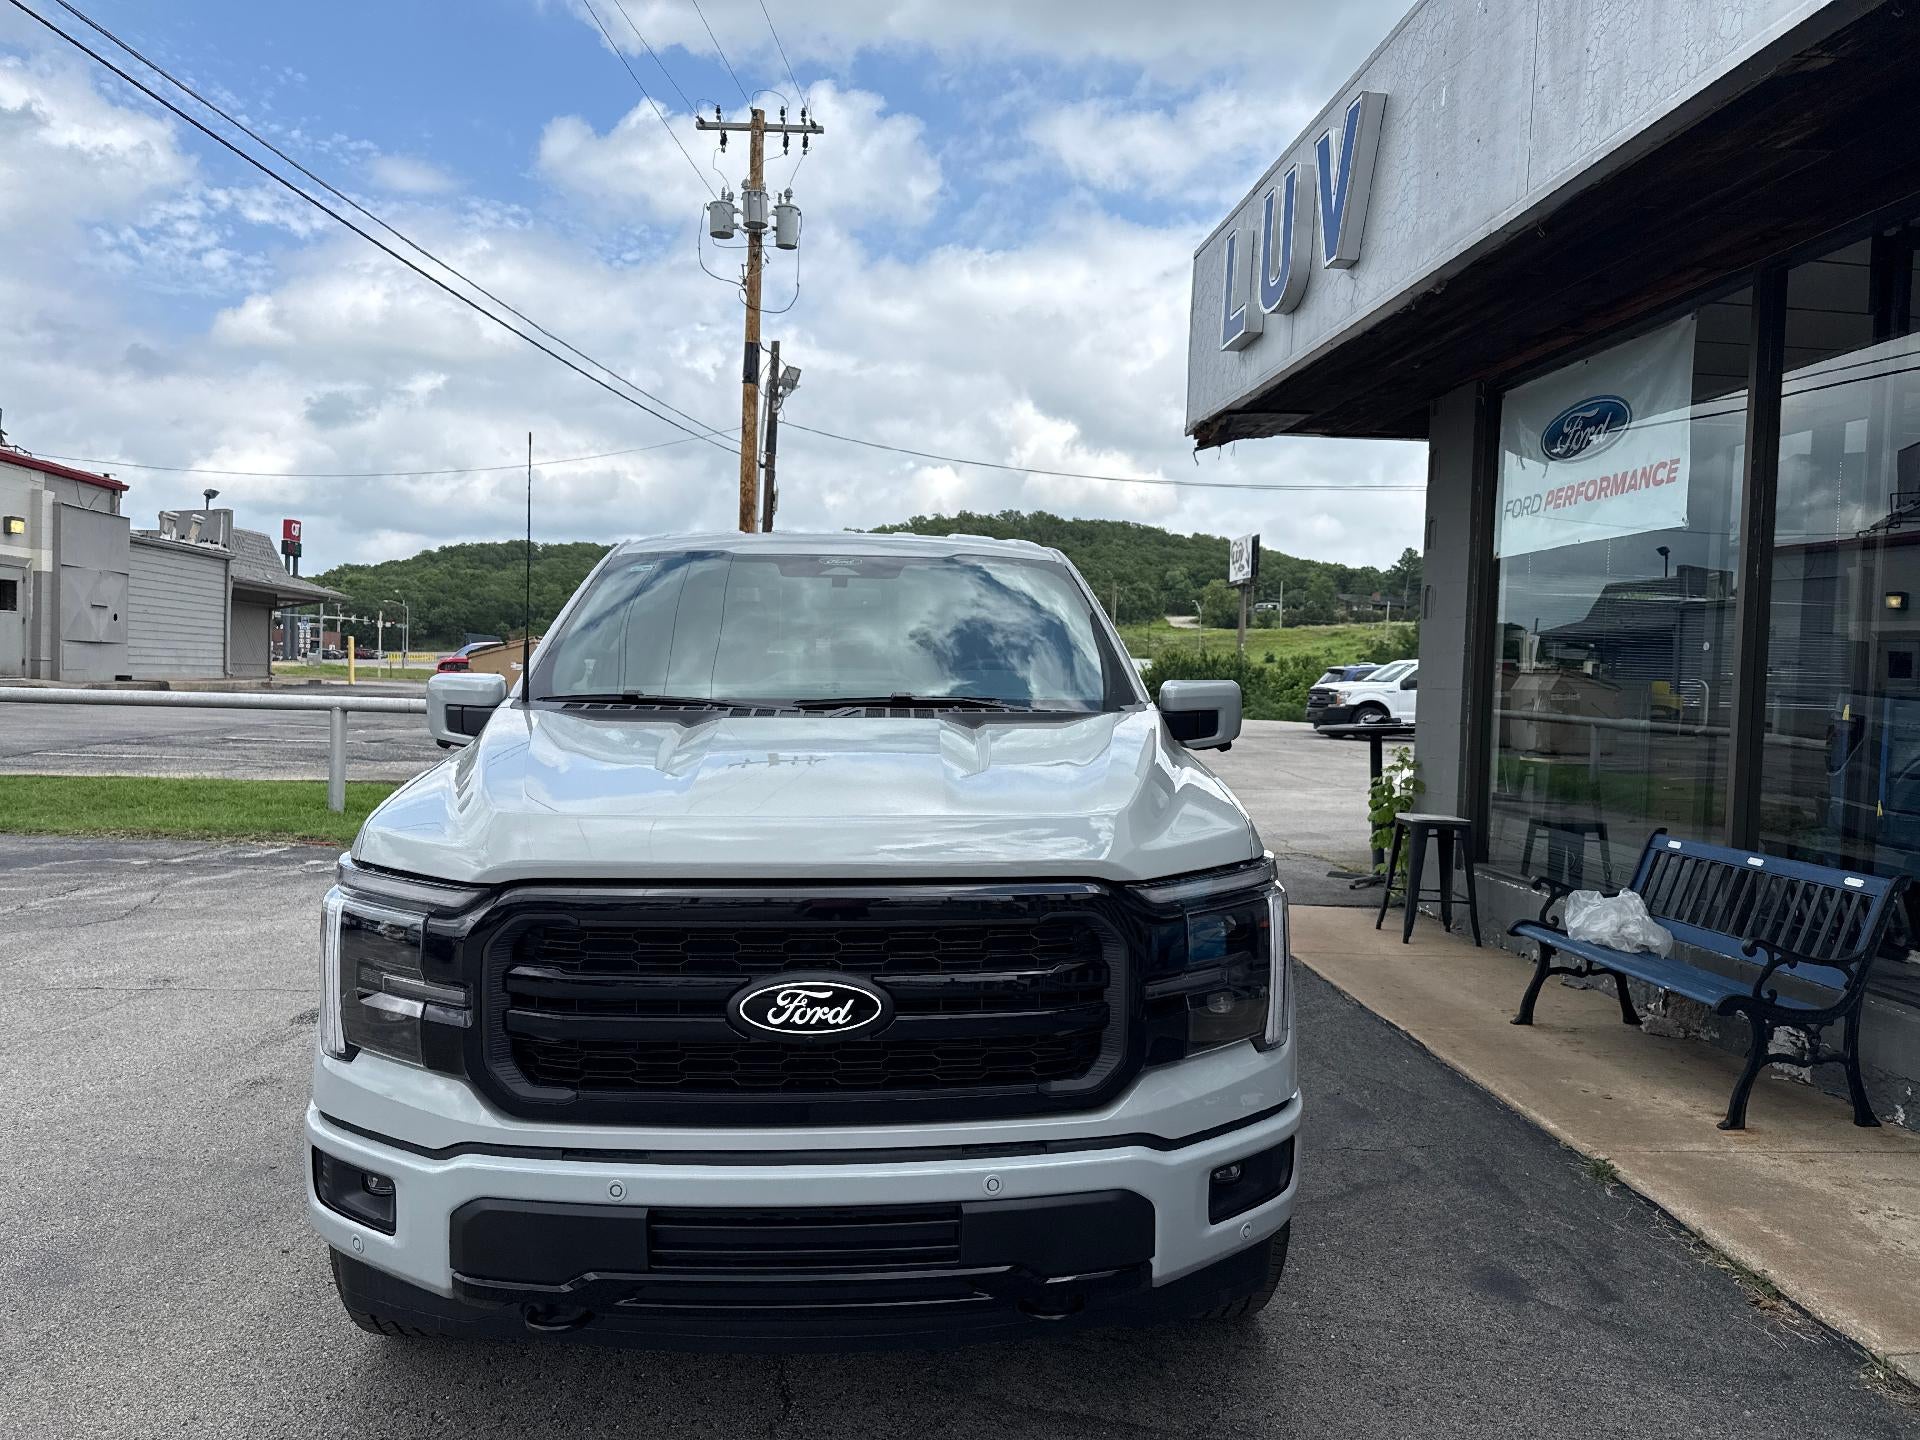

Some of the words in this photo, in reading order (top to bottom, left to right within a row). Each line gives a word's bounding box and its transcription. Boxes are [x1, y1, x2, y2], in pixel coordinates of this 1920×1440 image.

[1221, 91, 1384, 352] LUV
[1551, 408, 1612, 455] Ford
[1503, 493, 1542, 520] FORD
[1543, 458, 1680, 511] PERFORMANCE
[767, 989, 854, 1024] Ford
